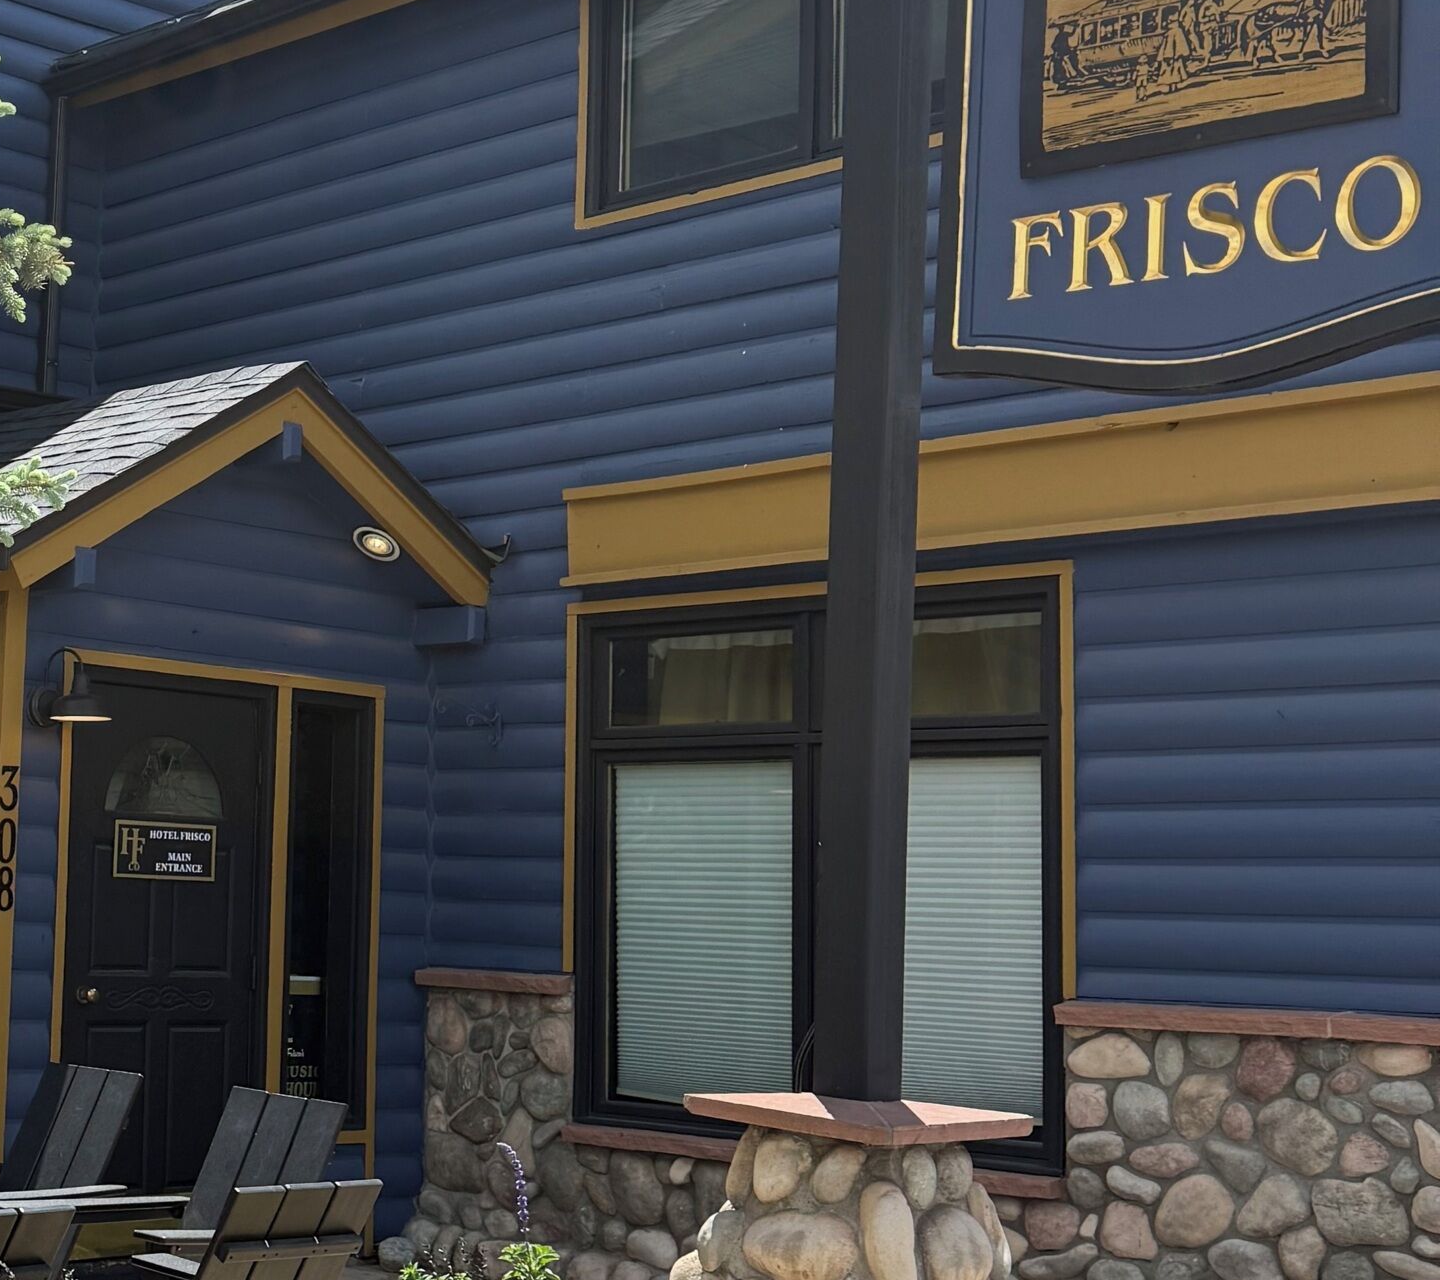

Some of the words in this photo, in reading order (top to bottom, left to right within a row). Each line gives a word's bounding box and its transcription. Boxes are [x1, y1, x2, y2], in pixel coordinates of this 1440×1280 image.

[1007, 154, 1422, 302] FRISCO
[149, 830, 179, 840] HOTEL
[180, 831, 211, 842] FRISCO
[167, 852, 192, 862] MAIN
[155, 862, 203, 873] ENTRANCE
[287, 1065, 319, 1078] USI
